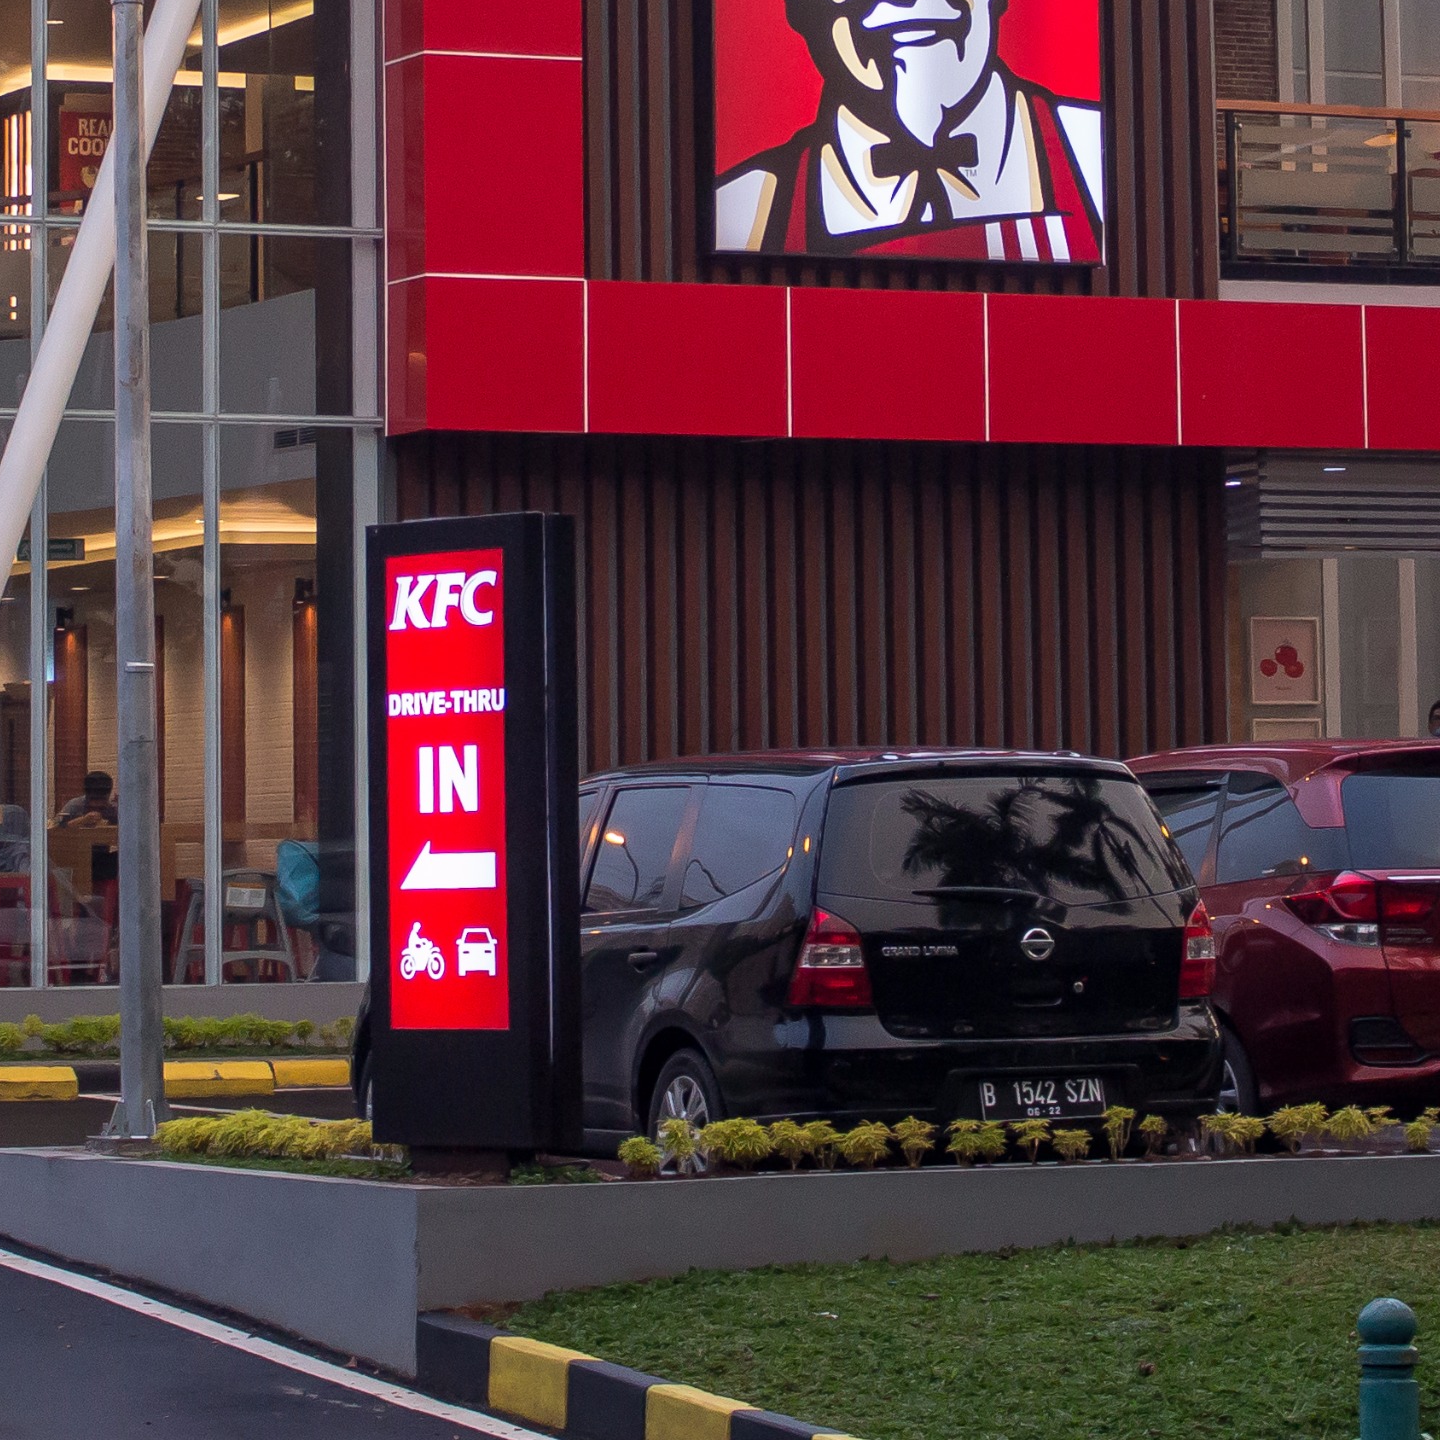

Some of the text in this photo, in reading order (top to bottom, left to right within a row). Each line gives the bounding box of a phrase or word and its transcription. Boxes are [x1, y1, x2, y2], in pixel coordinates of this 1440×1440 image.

[389, 570, 498, 631] KFC
[388, 688, 506, 717] DRIVE-THRU
[418, 744, 479, 814] IN
[982, 1078, 1102, 1107] B 1542 SZN
